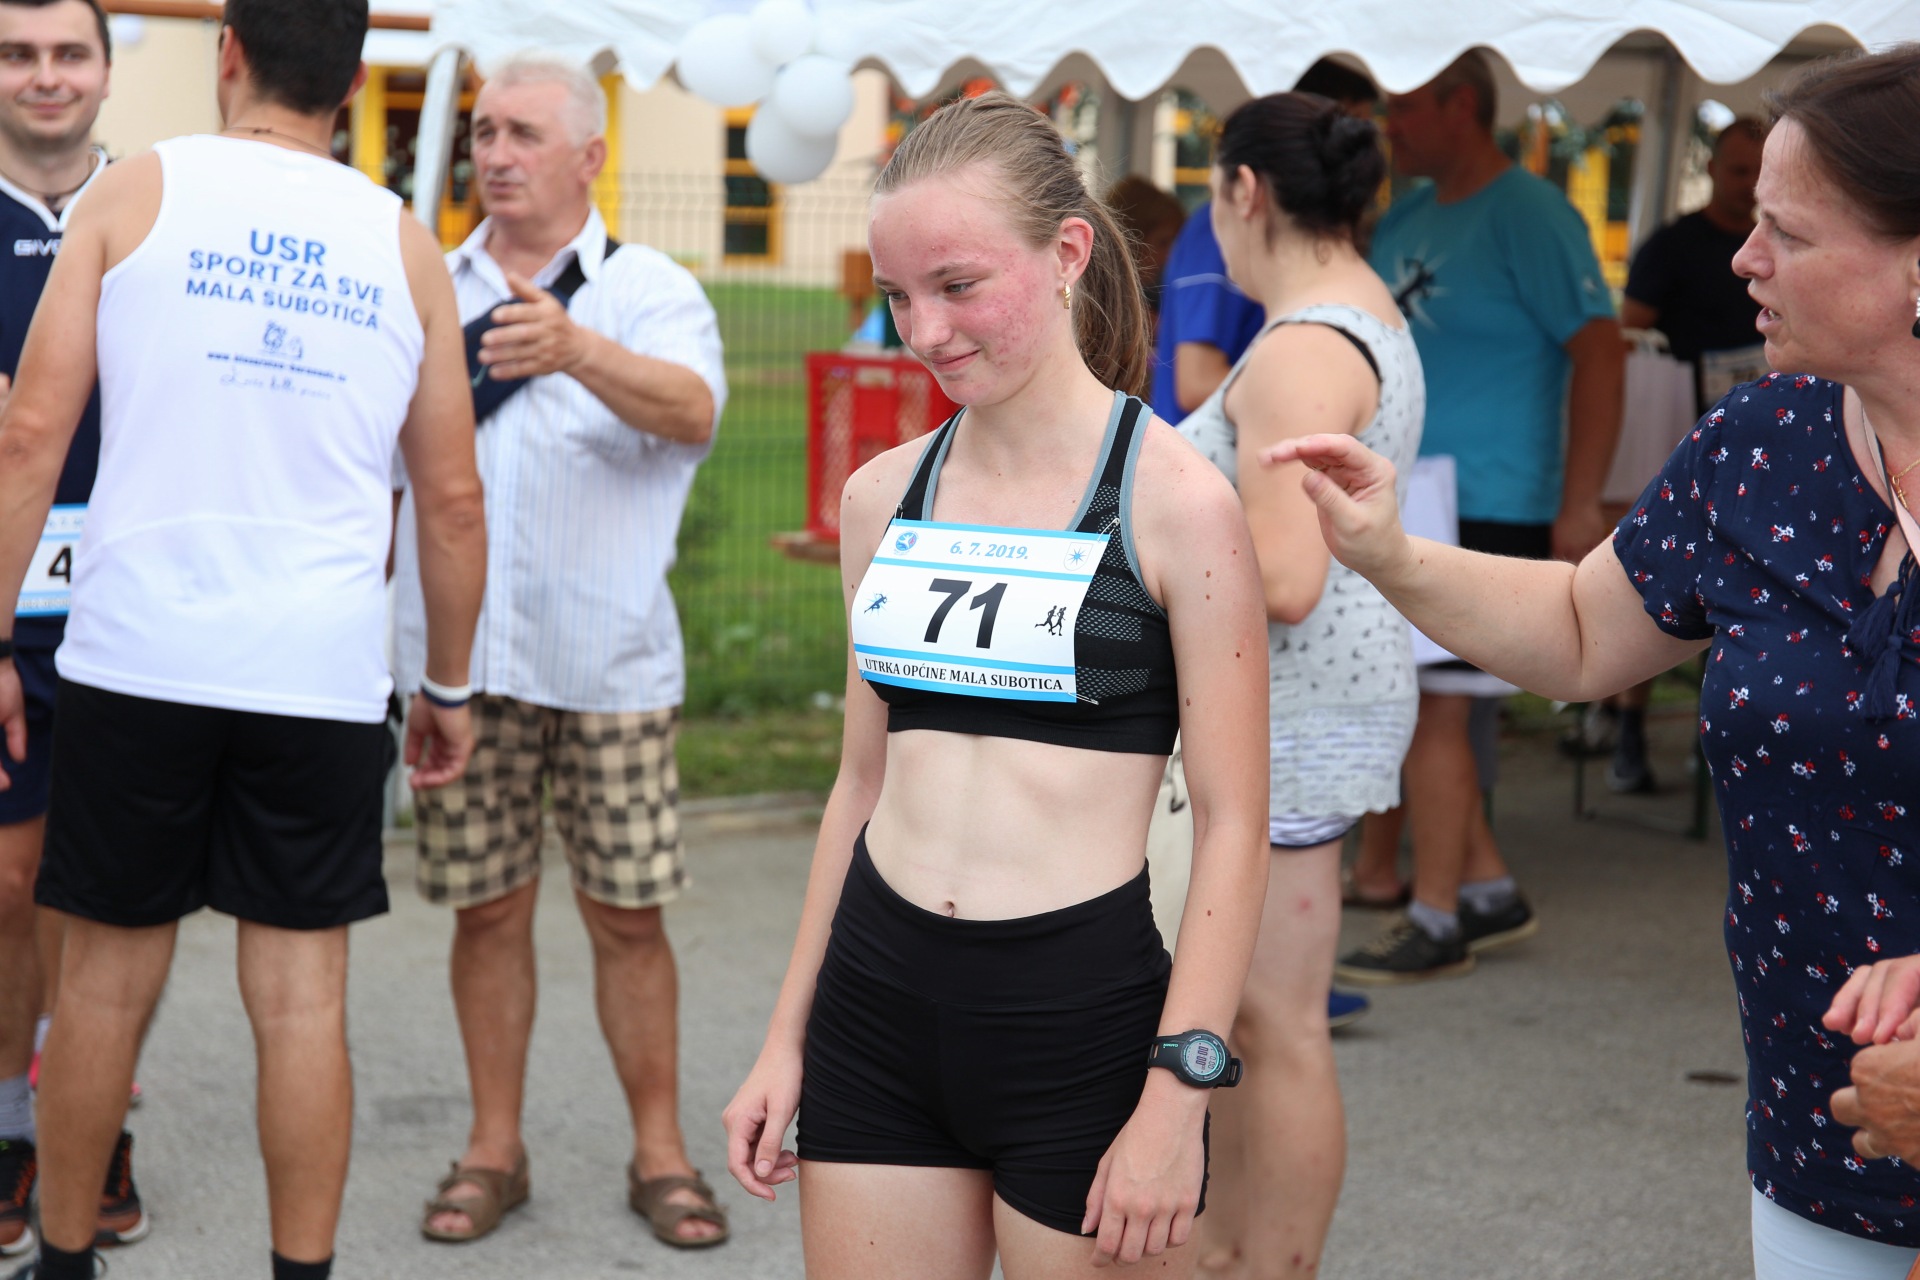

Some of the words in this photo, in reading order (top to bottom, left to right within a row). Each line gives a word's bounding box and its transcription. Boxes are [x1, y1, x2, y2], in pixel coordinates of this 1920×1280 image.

[250, 229, 327, 266] USR
[189, 249, 283, 283] SPORT
[291, 268, 327, 291] ZA
[338, 276, 384, 306] SVE
[186, 278, 254, 303] MALA
[263, 291, 379, 330] SUBOTICA
[950, 541, 962, 555] 6.
[969, 543, 981, 556] 7.
[985, 544, 1029, 559] 2019.
[923, 578, 1008, 649] 71
[864, 658, 900, 675] UTRKA
[903, 663, 947, 680] OPĆINE
[949, 669, 986, 686] MALA
[990, 674, 1063, 691] SUBOTICA
